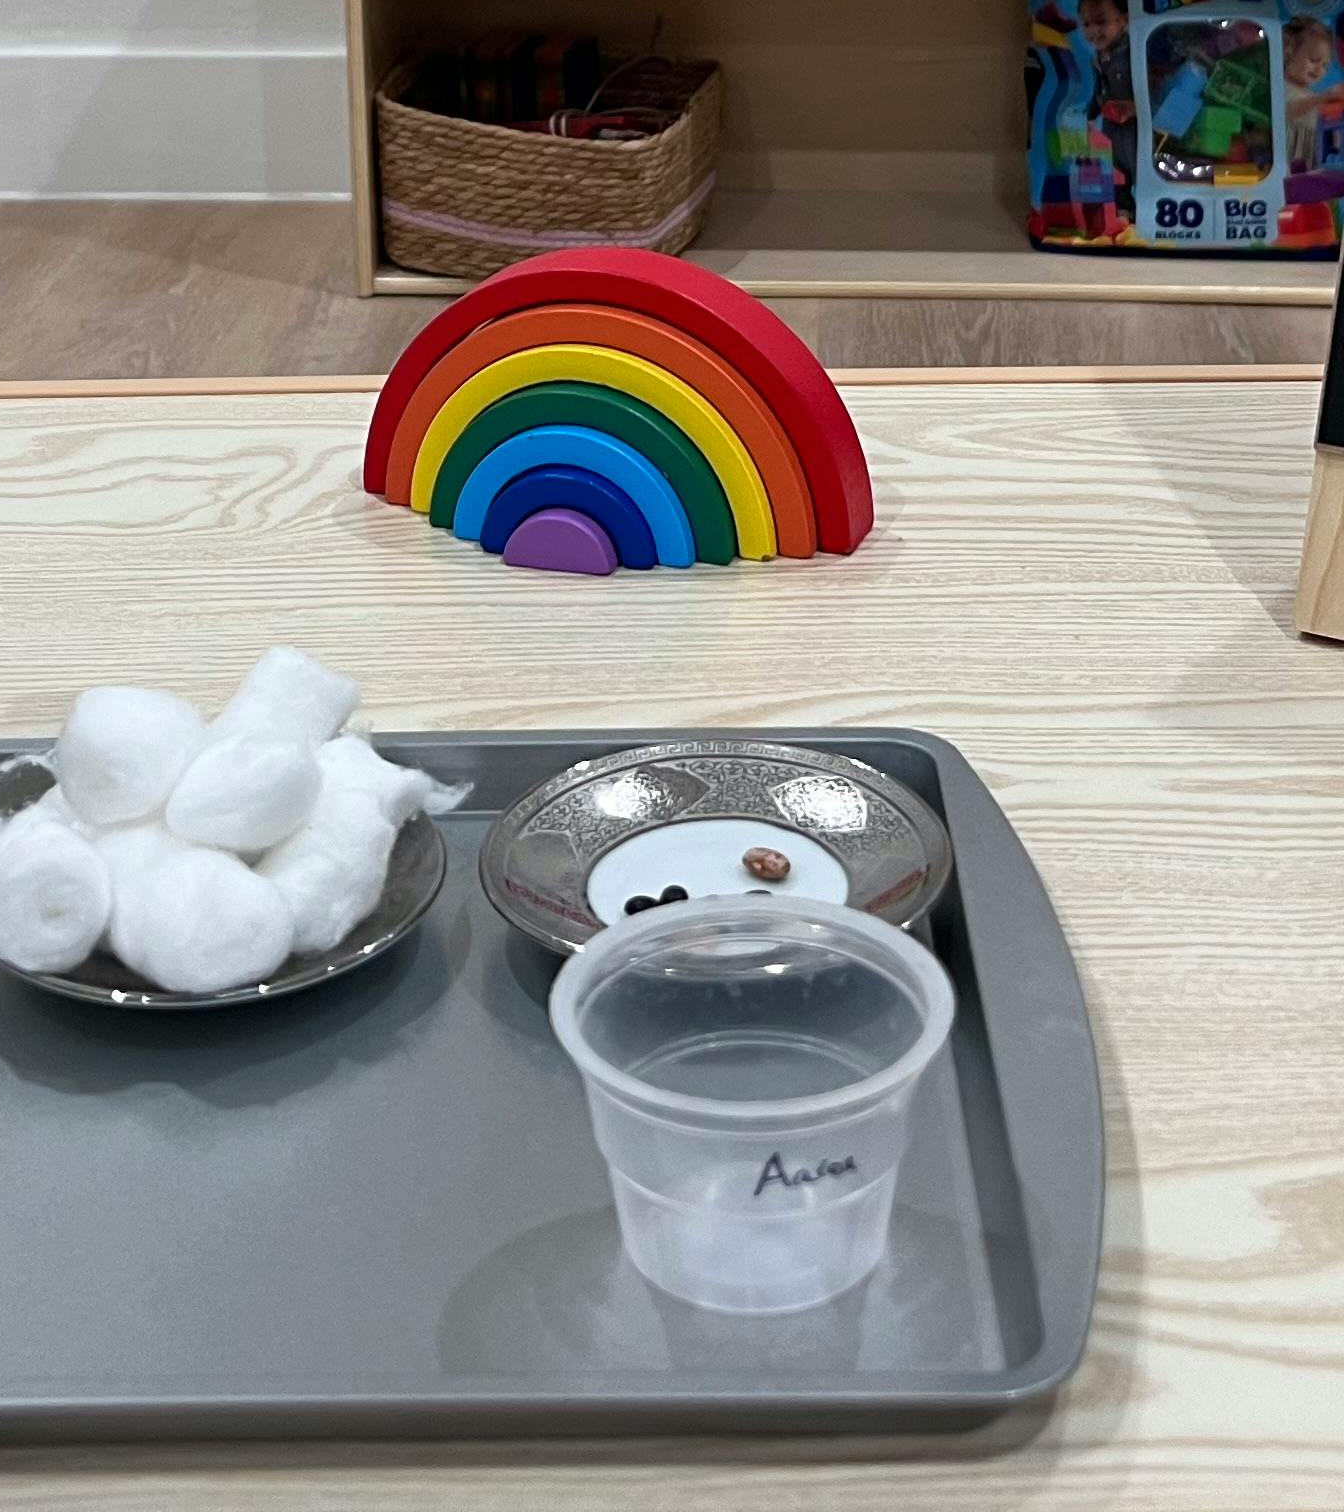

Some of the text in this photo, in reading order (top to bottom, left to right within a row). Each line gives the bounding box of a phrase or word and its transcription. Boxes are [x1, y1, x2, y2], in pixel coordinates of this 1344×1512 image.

[1155, 197, 1204, 228] 80
[1224, 198, 1267, 217] BIG
[1155, 230, 1201, 240] BLOCKS
[1225, 226, 1266, 240] BAG
